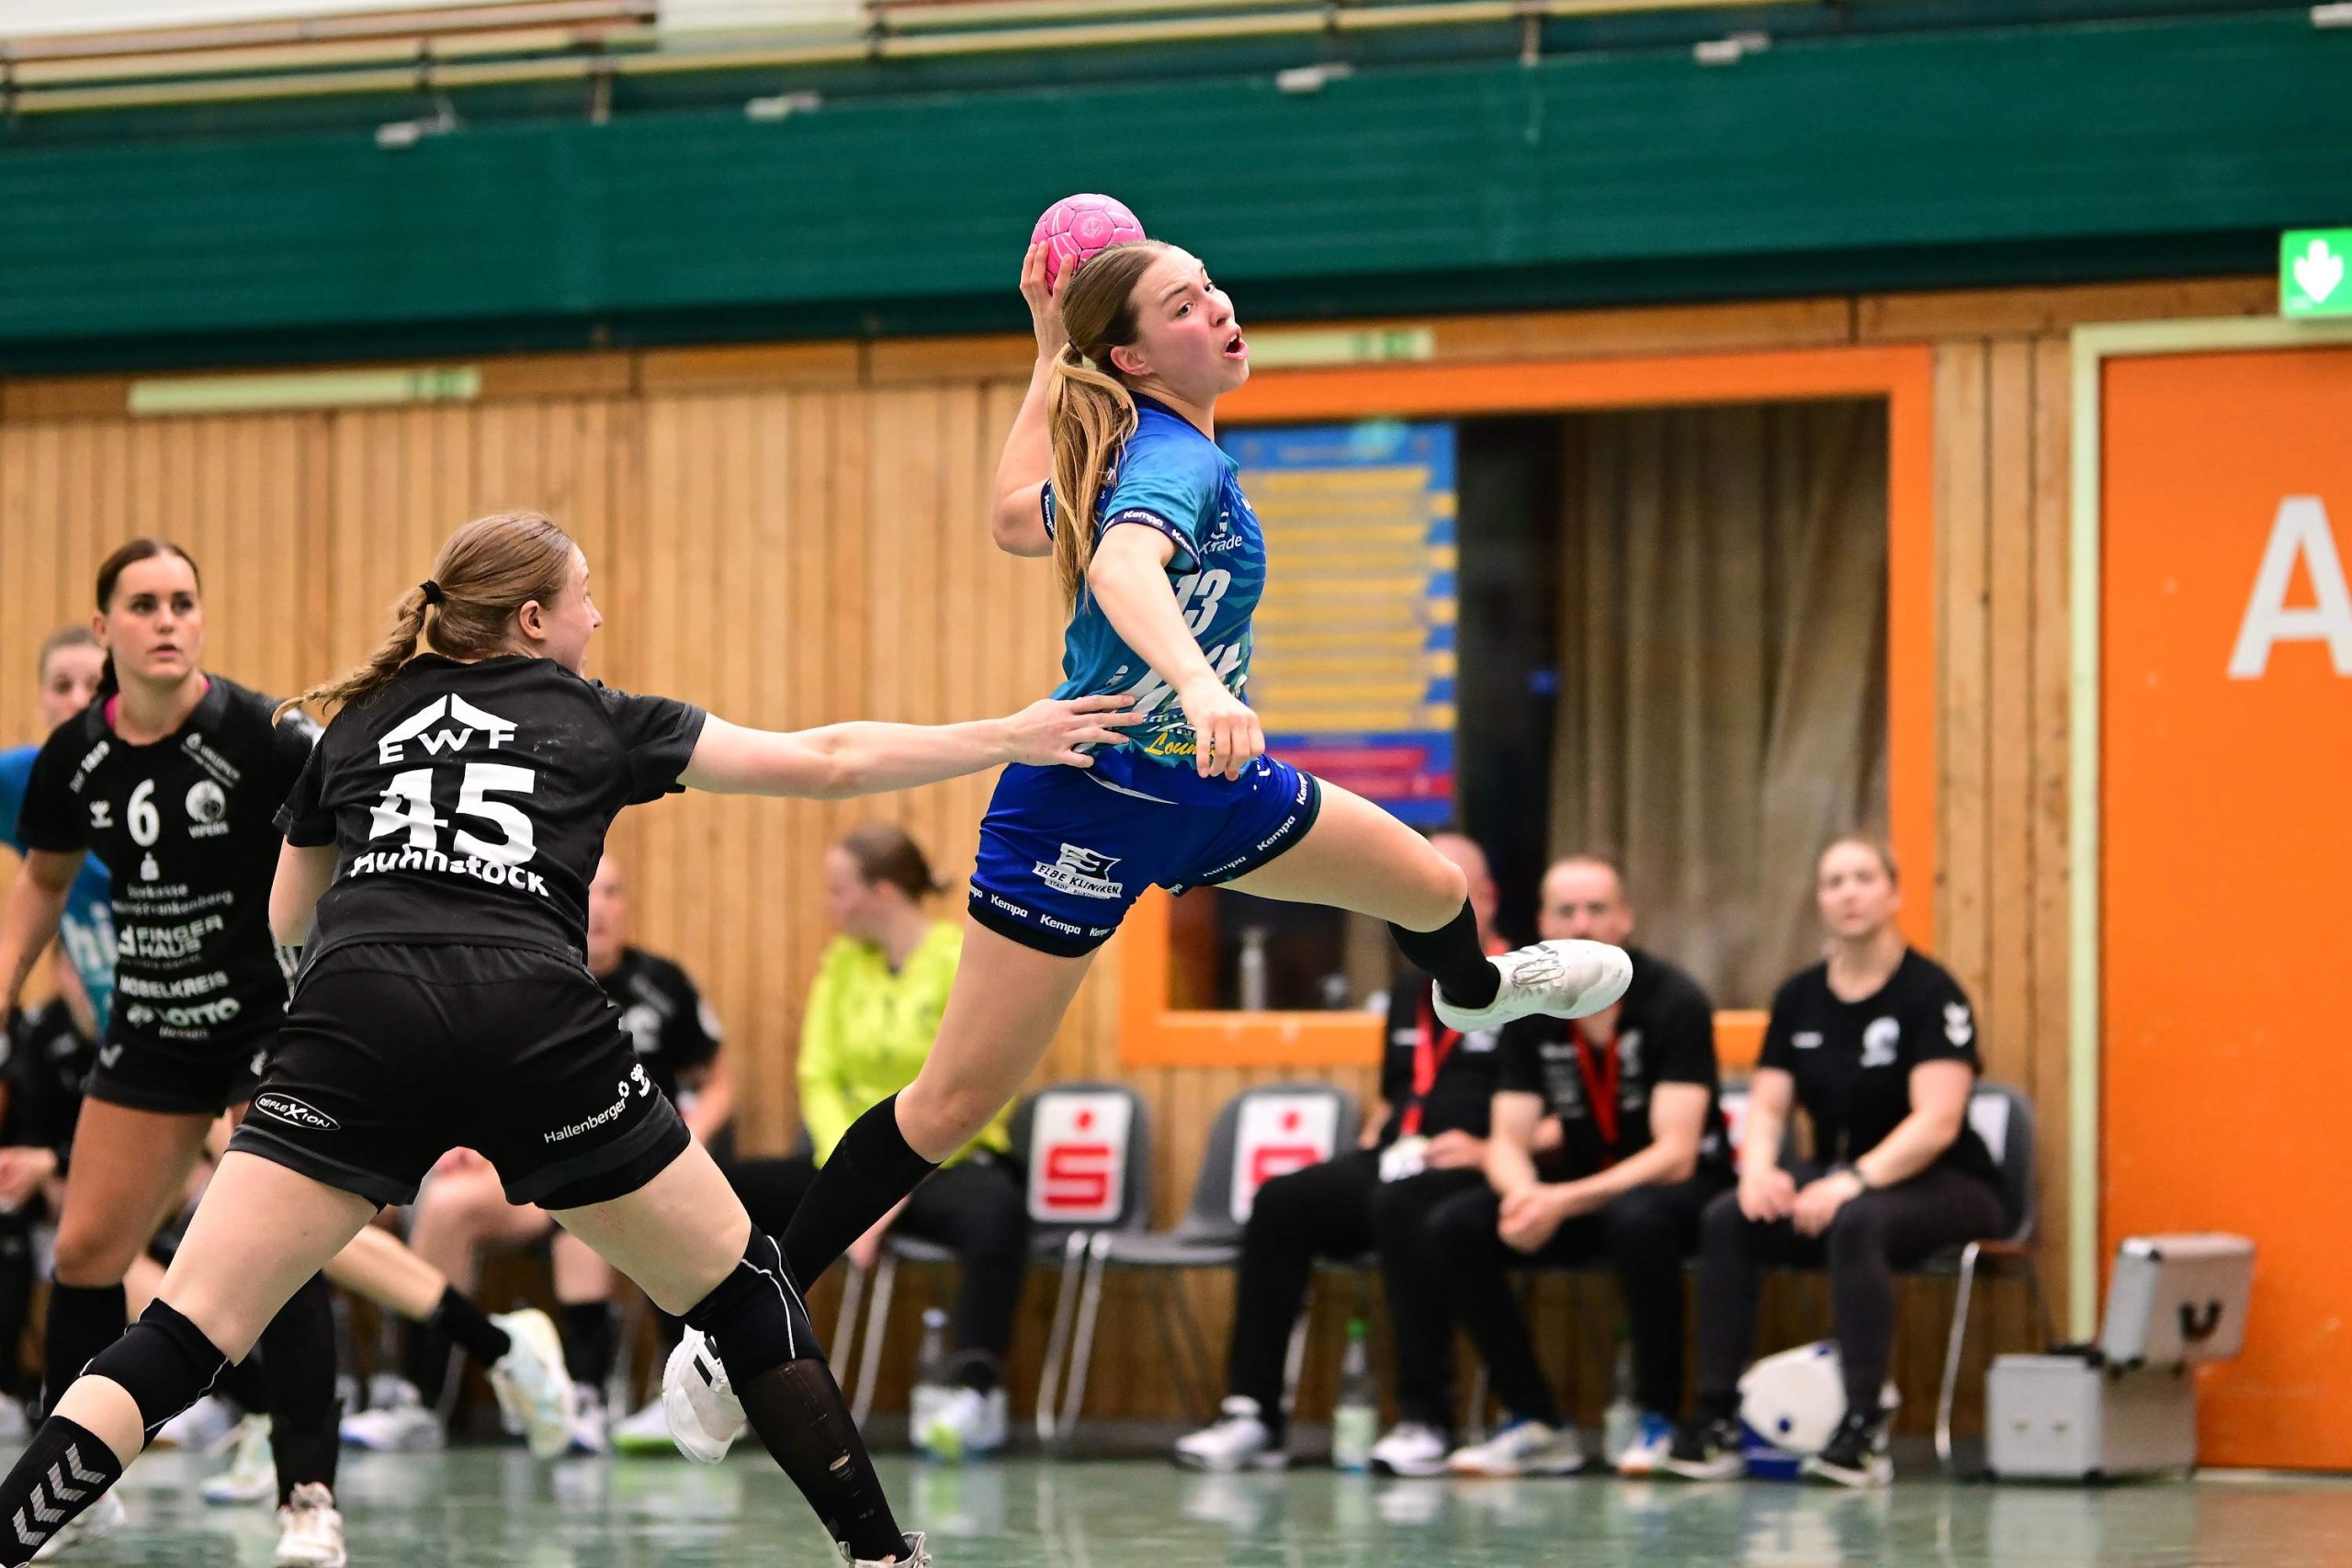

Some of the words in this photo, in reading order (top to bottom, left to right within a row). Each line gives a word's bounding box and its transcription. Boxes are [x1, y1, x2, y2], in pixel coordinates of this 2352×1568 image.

[1123, 511, 1164, 528] Kempa
[1175, 569, 1231, 637] 13
[378, 726, 516, 765] EWF
[127, 778, 161, 847] 6
[368, 762, 537, 866] 45
[1256, 815, 1296, 852] Kempa
[1037, 864, 1068, 882] ELBE
[1069, 876, 1119, 895] KLINIKEN
[990, 894, 1028, 919] Kempa
[136, 914, 224, 942] FINGER
[1040, 914, 1081, 935] Kempa
[138, 938, 202, 959] HAUS
[258, 1098, 331, 1128] REFLEXION
[544, 1098, 626, 1144] Hallenberger
